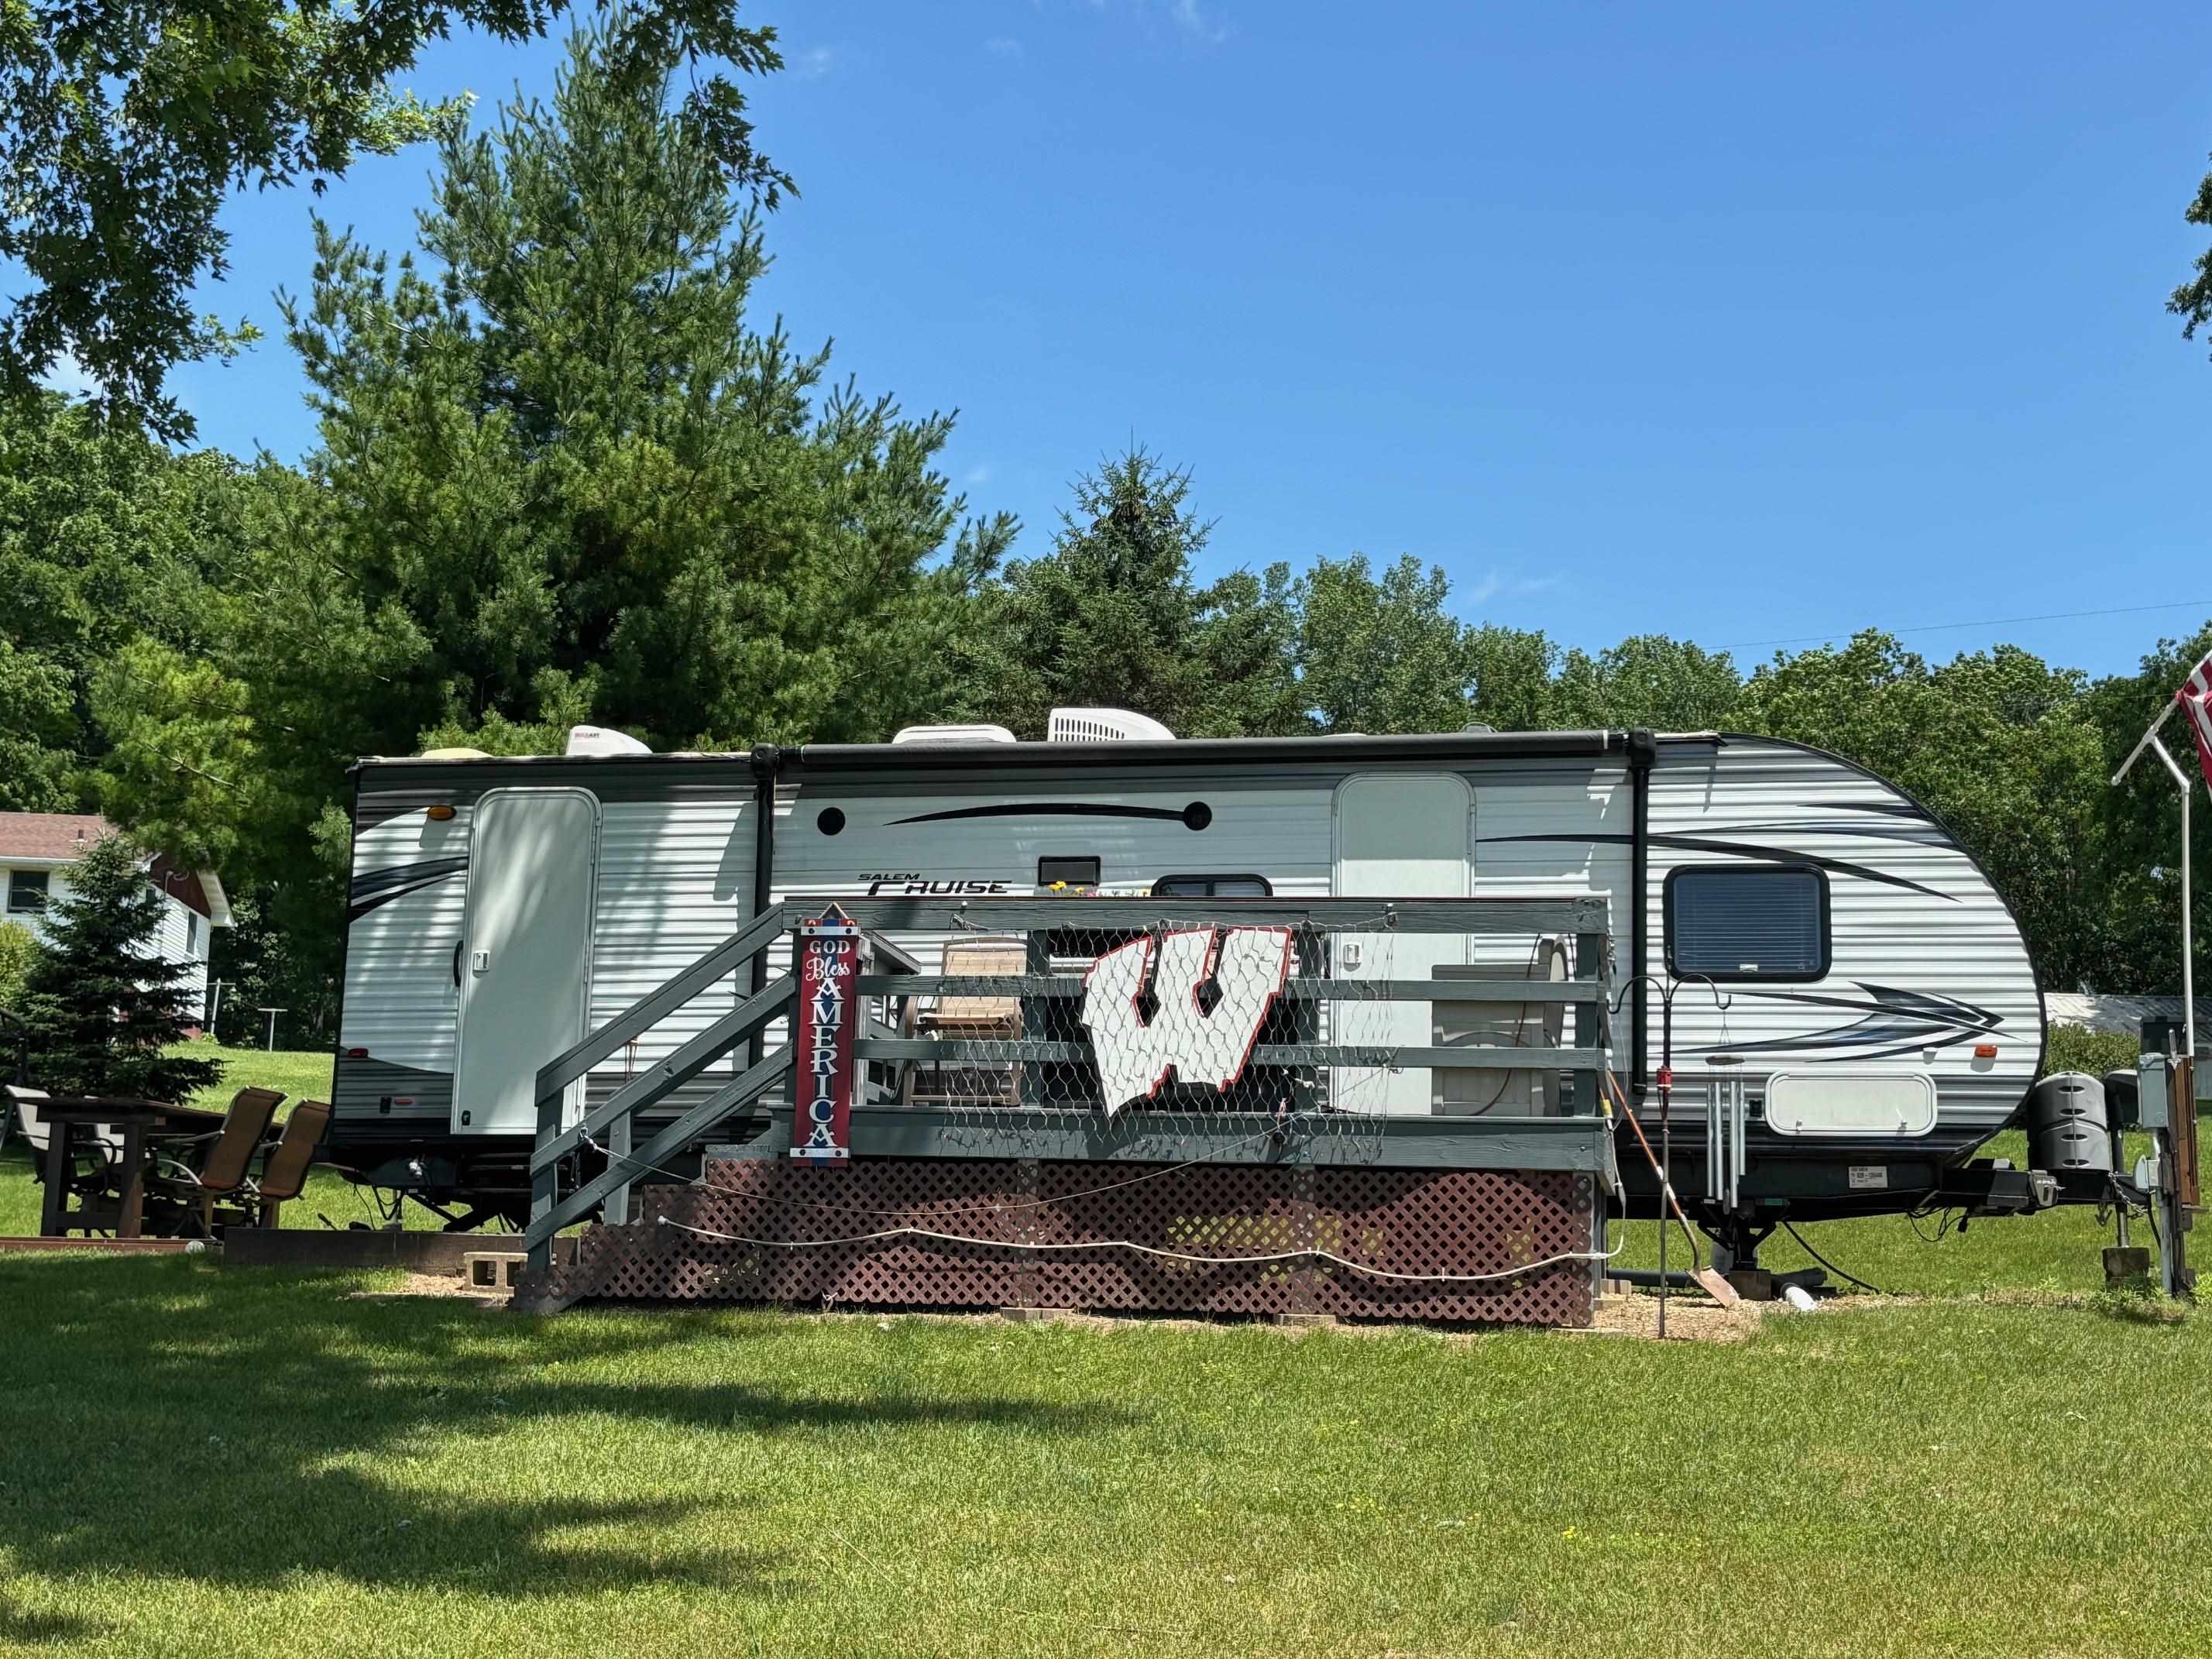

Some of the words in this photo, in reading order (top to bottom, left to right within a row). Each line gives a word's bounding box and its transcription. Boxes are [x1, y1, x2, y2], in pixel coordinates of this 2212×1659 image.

[867, 881, 1012, 896] CRUISE
[809, 941, 850, 954] GOD
[805, 957, 850, 982] Bless
[1082, 927, 1292, 1118] W
[803, 977, 844, 1147] AMERICA
